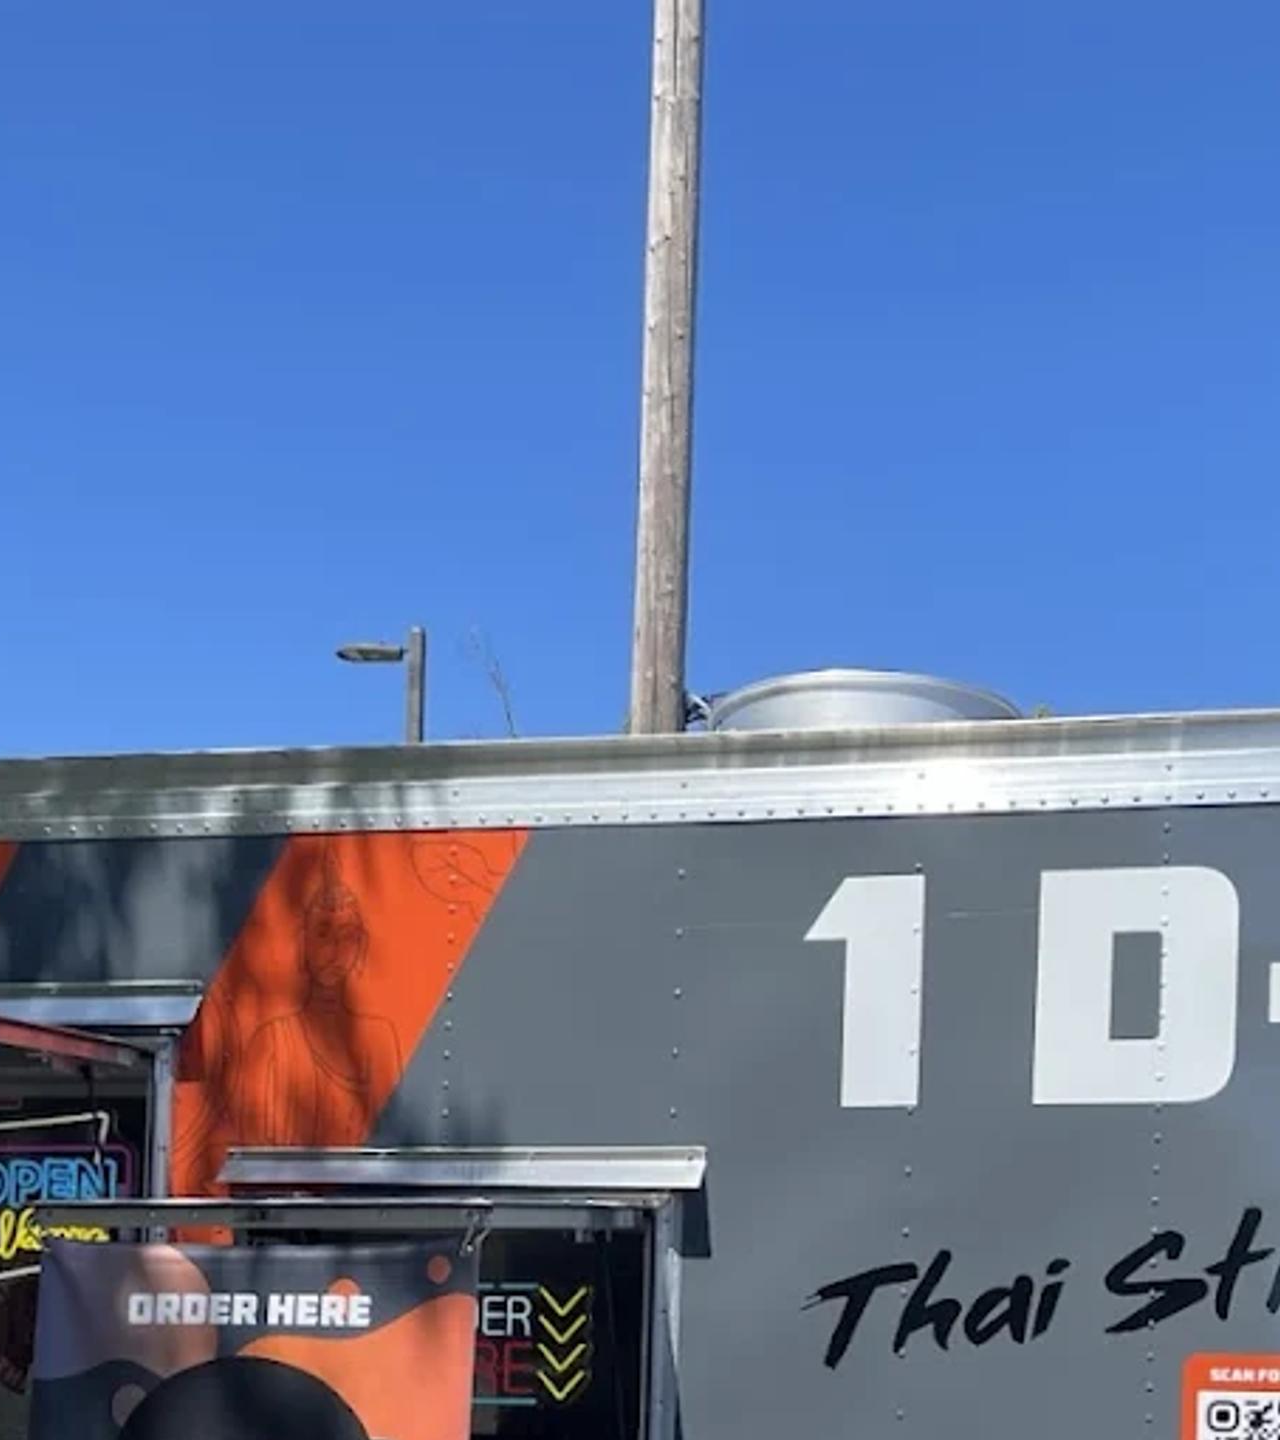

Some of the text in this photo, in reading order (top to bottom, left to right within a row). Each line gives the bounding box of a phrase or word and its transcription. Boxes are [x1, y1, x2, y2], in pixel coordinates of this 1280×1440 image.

[803, 873, 925, 1107] 1
[128, 1292, 373, 1328] ORDER HERE
[801, 1249, 1070, 1370] Thai
[1209, 1368, 1255, 1382] SCAN
